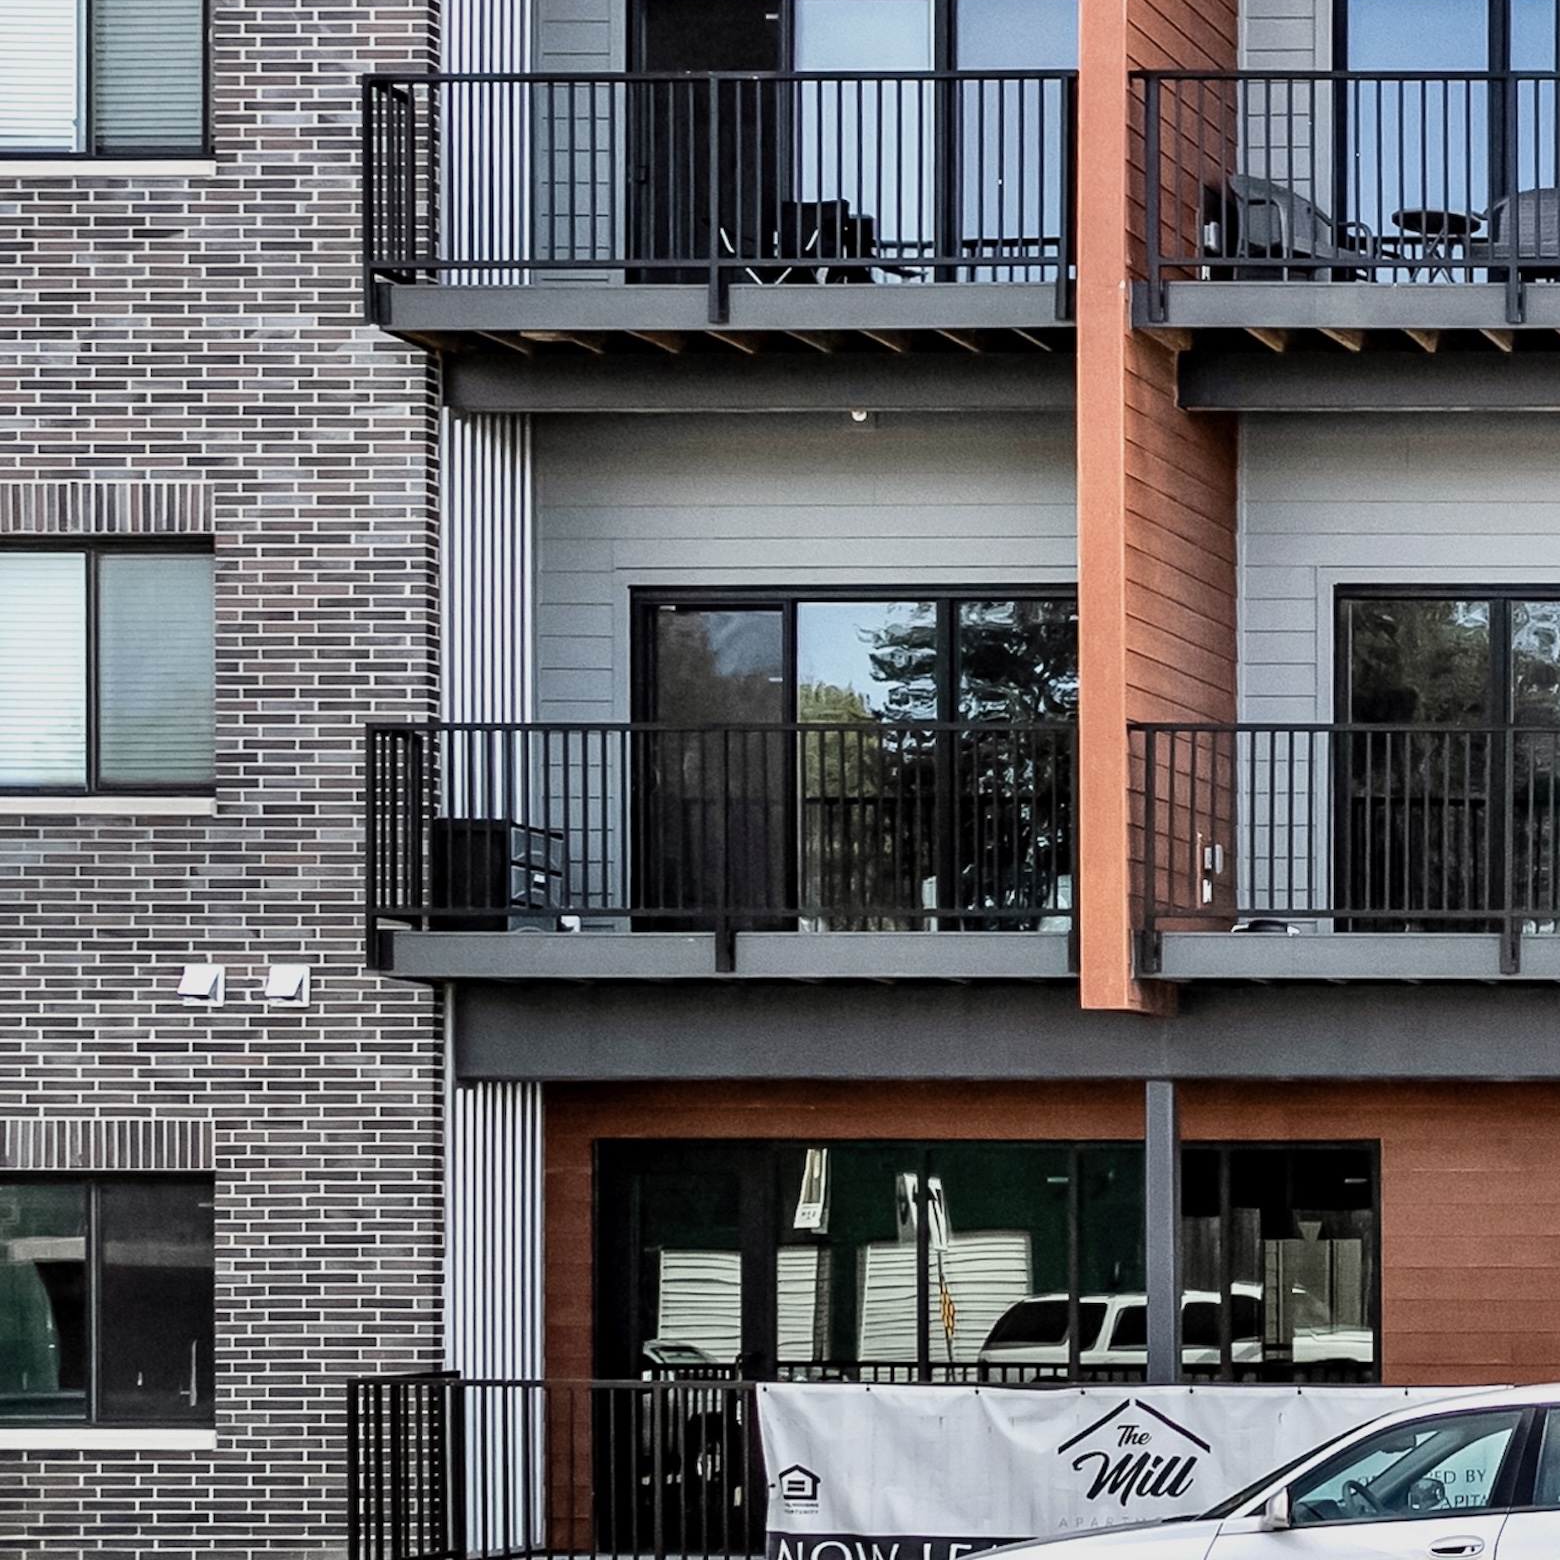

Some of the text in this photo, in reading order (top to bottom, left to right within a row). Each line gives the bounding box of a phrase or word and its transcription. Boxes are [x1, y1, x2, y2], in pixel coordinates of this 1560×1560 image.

[1117, 1425, 1152, 1447] The
[1072, 1451, 1198, 1507] Mill
[1466, 1469, 1487, 1483] BY
